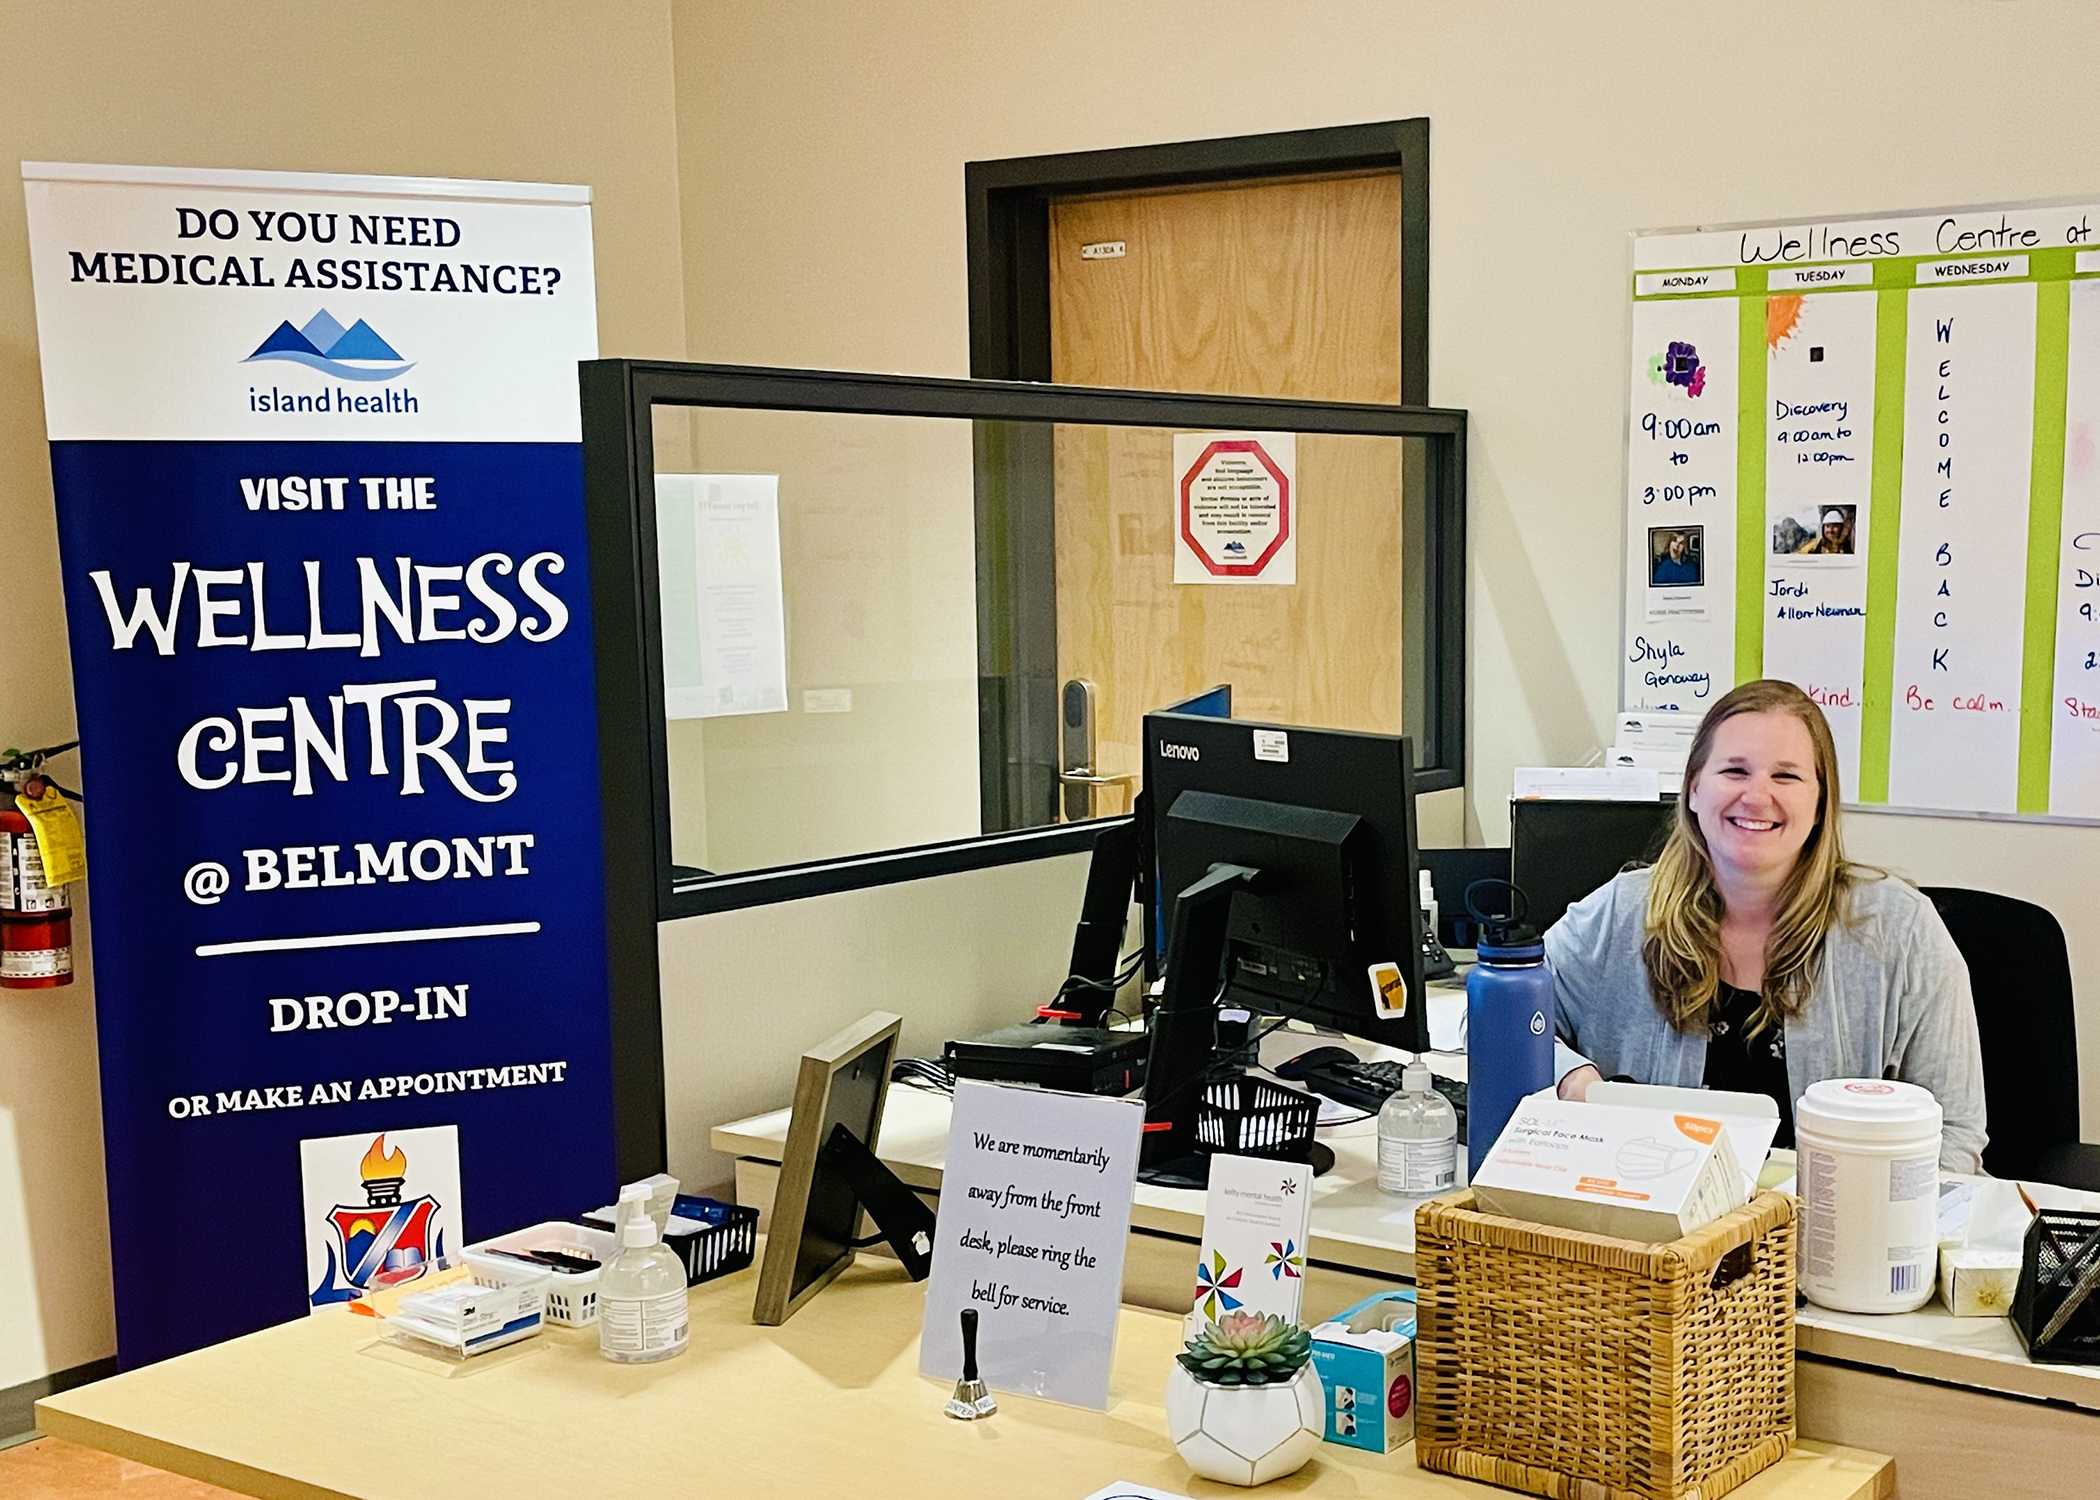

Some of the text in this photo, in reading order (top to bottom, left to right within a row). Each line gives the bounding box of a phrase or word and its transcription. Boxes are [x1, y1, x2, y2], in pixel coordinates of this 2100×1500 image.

[176, 207, 461, 248] DO YOU NEED
[1740, 214, 2092, 263] Wellness Centre at
[69, 252, 562, 296] MEDICAL ASSISTANCE?
[1662, 275, 1710, 288] MONDAY
[1794, 270, 1846, 282] TUESDAY
[1935, 262, 2010, 277] WEDNESDAY
[249, 387, 419, 414] island health
[1776, 400, 1848, 422] Discovery
[1669, 451, 1689, 466] to
[239, 476, 438, 511] VISIT THE
[89, 551, 570, 658] WELLNESS
[1769, 579, 1809, 597] Jordi
[1629, 636, 1685, 670] Shyla
[1906, 685, 1935, 711] Be
[177, 679, 518, 803] CENTRE
[1160, 738, 1200, 762] Lenovo
[183, 834, 535, 904] @ BELMONT
[269, 984, 470, 1033] DROP-IN
[168, 1061, 568, 1119] OR MAKE AN APPOINTMENT
[973, 1131, 1111, 1173] We are momentarily
[1513, 1126, 1605, 1144] Surgical Face Mask
[1528, 1138, 1570, 1151] Earloops
[968, 1184, 1101, 1219] away from the front
[959, 1228, 1097, 1271] desk, please ring the
[971, 1279, 1070, 1316] bell for service.
